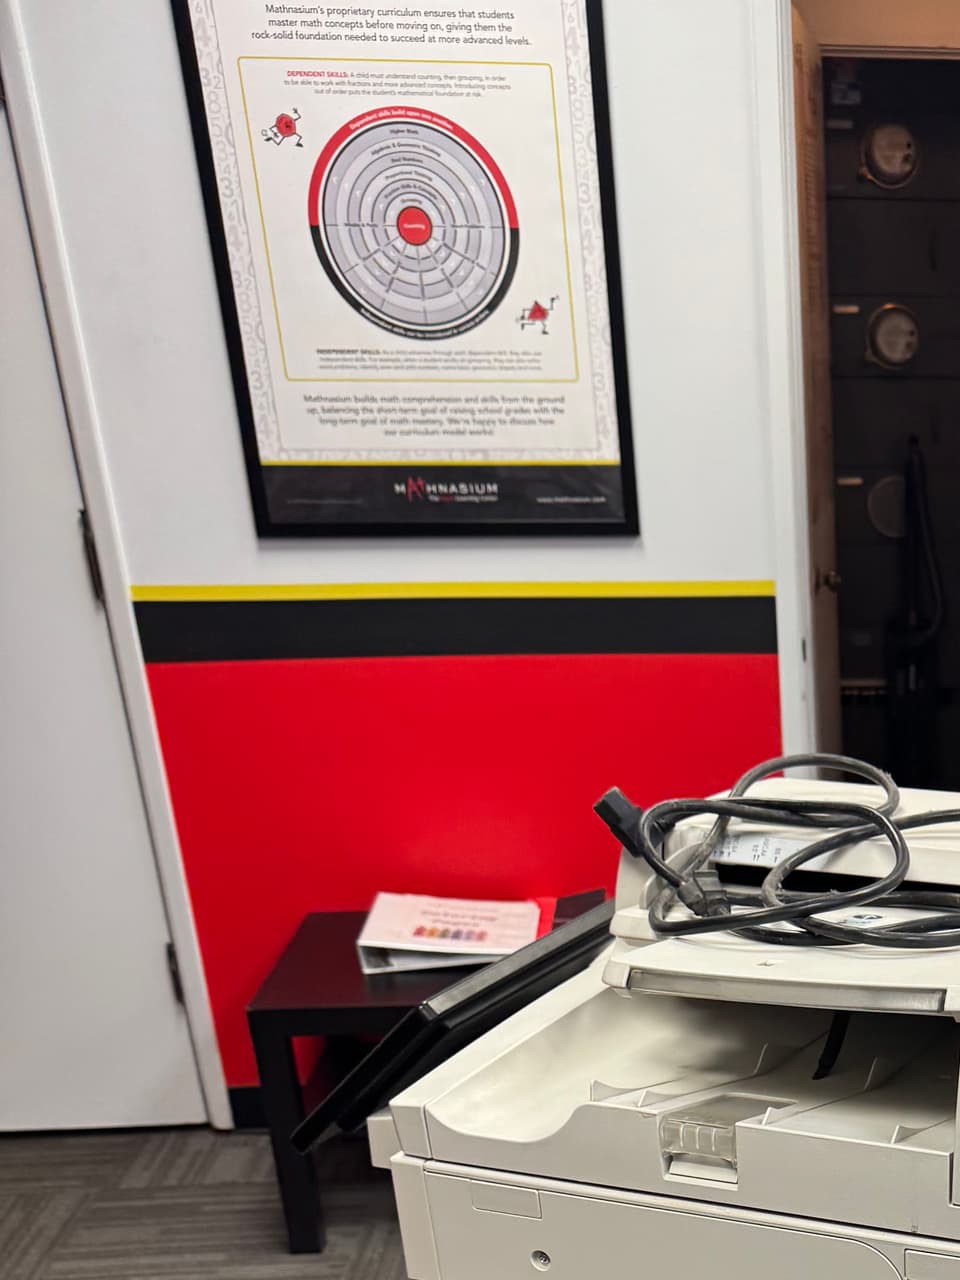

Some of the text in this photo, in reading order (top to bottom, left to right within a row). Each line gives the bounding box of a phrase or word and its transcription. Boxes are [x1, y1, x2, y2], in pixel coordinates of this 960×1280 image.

[264, 4, 514, 19] Mathnasium's proprietary curriculum ensures that students
[268, 18, 512, 34] master math concepts before moving on, giving them the
[251, 30, 294, 39] rock-solid
[294, 31, 342, 41] foundation
[344, 32, 376, 41] needed
[378, 32, 388, 42] to
[390, 33, 424, 43] succeed
[428, 33, 436, 43] at
[462, 34, 502, 44] advanced
[504, 35, 532, 45] levels.
